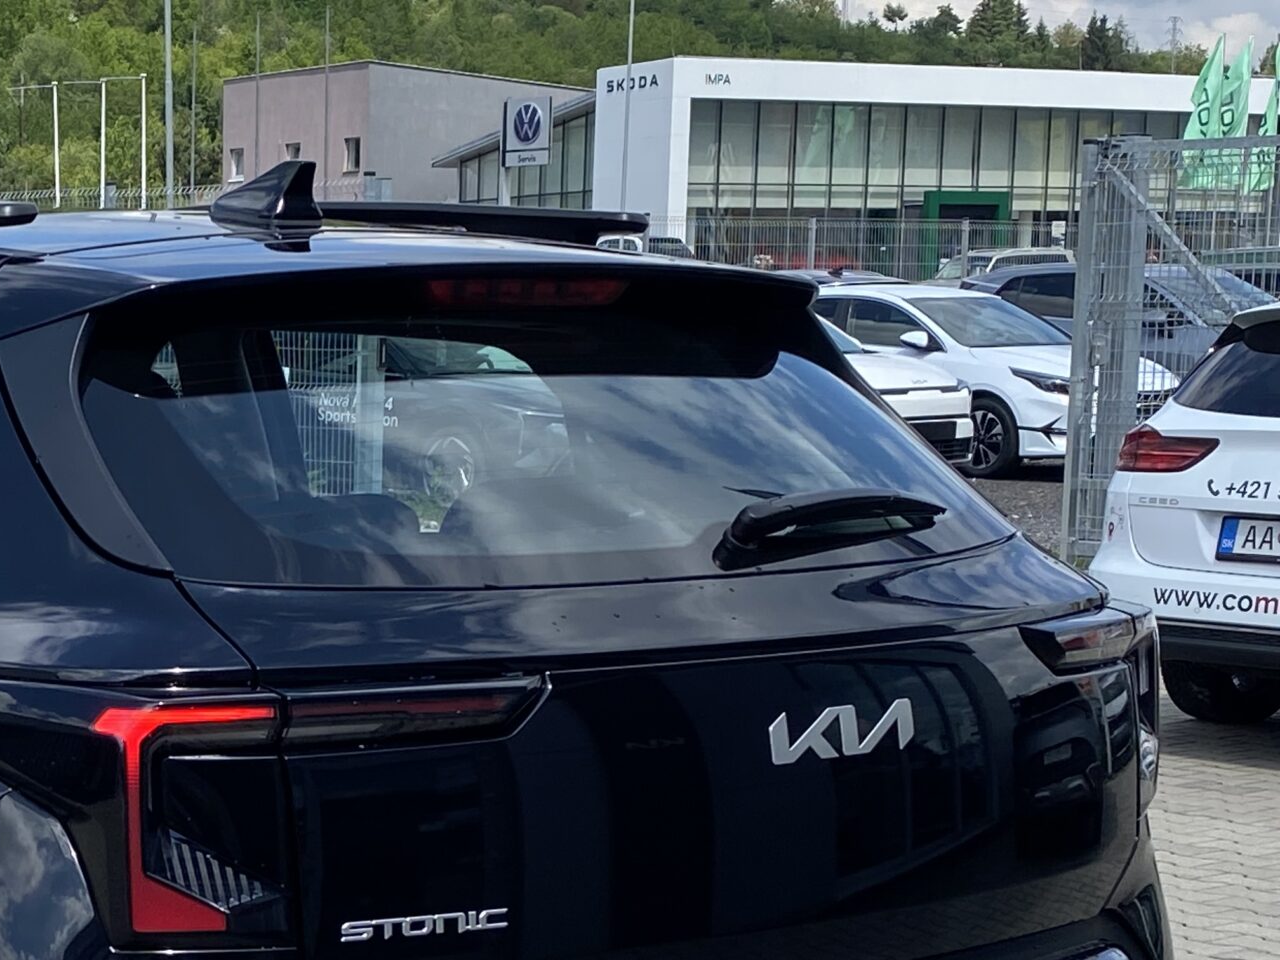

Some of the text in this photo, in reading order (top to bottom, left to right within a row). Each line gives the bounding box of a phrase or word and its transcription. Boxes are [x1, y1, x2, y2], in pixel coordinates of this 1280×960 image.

[705, 73, 731, 86] IMPA
[1225, 480, 1271, 499] +421
[1221, 539, 1234, 548] SK
[1241, 525, 1274, 550] AA
[768, 698, 914, 764] KIA
[340, 908, 508, 942] STONIC
